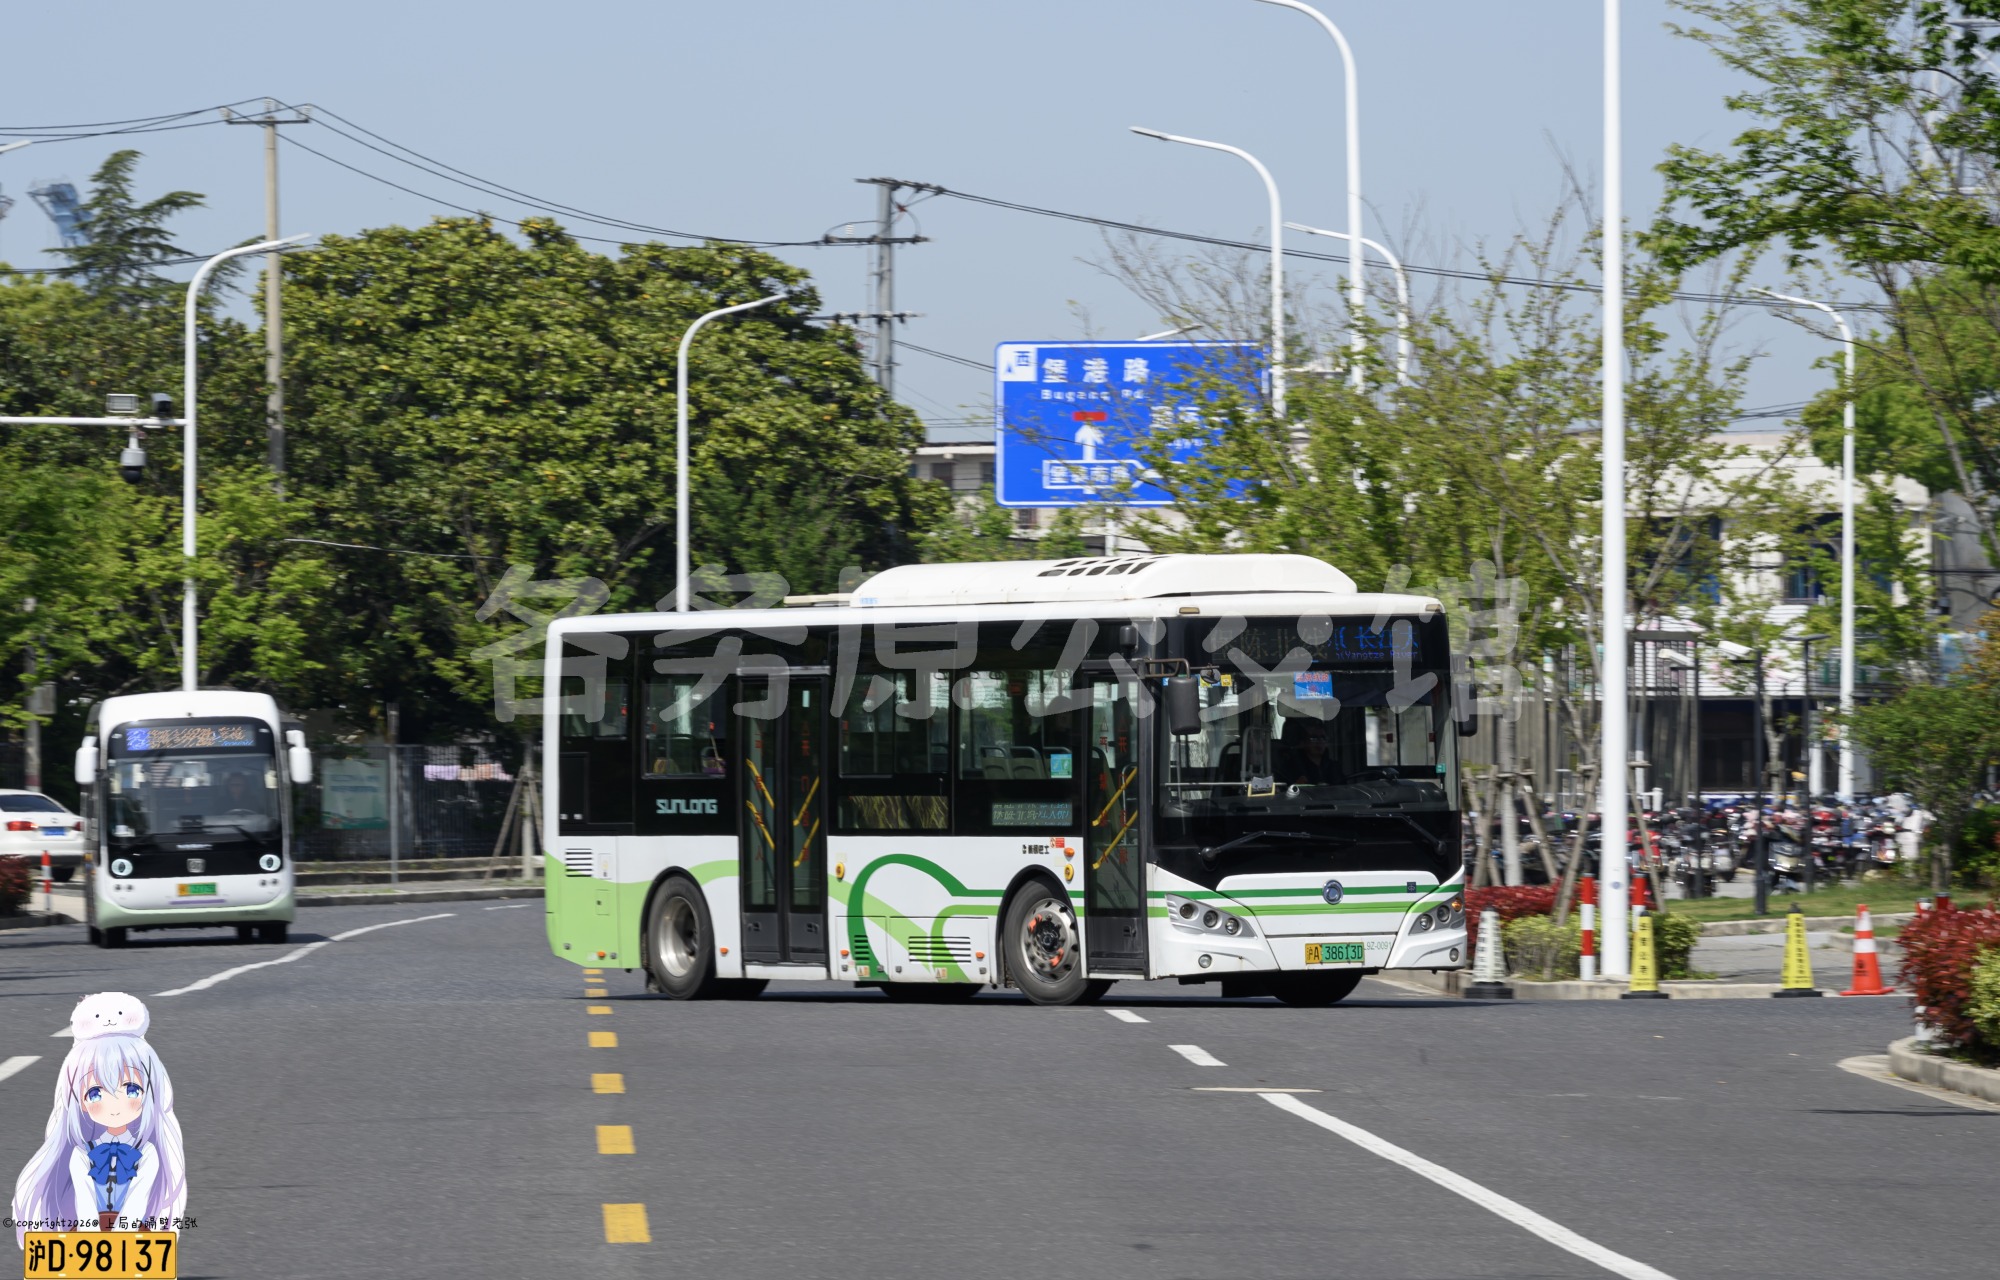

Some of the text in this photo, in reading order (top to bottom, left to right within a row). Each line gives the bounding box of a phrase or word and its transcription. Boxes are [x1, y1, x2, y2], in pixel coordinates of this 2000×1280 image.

[1042, 357, 1151, 384] 堡港路
[656, 799, 718, 814] SUNLONG
